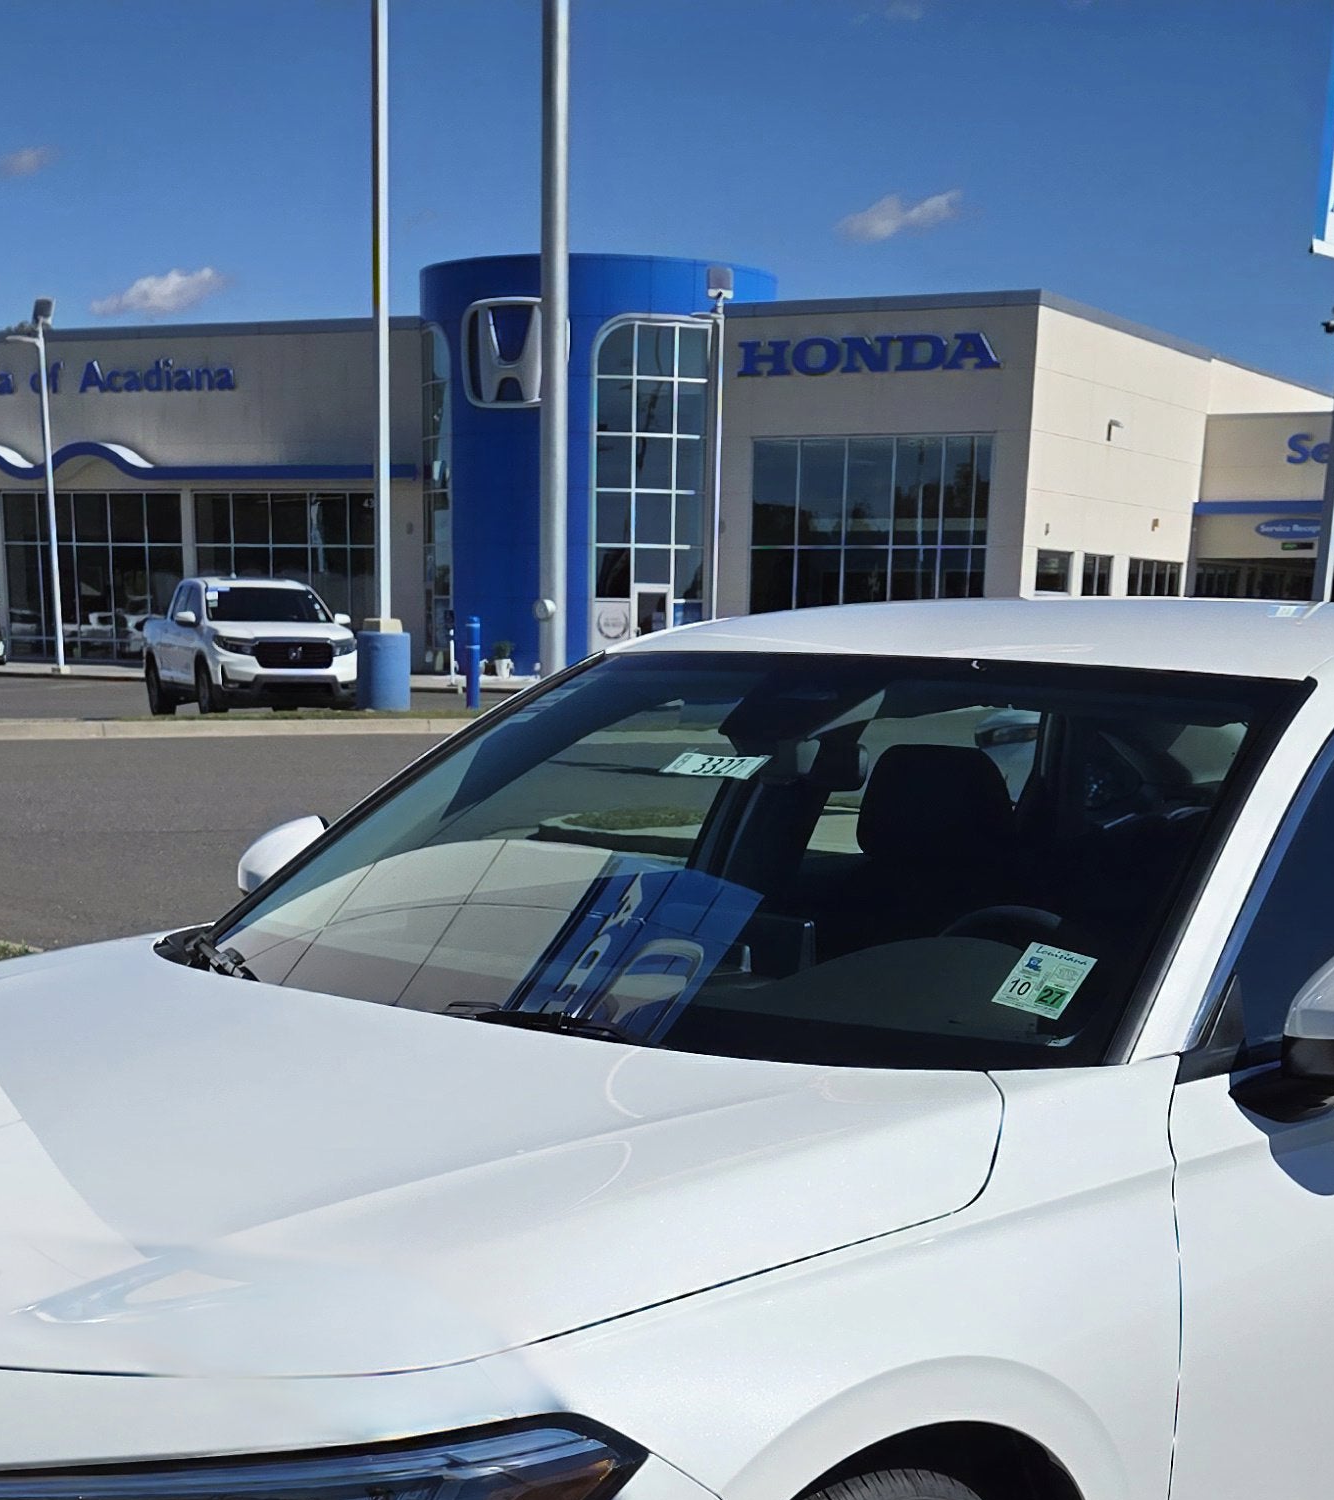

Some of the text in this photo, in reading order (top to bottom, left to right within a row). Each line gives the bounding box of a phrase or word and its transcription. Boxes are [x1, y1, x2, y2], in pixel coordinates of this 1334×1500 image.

[737, 332, 1002, 377] HONDA
[29, 360, 62, 394] of
[79, 358, 236, 394] Acadiana
[1035, 945, 1088, 966] Louisiana
[1008, 977, 1032, 996] 10
[1037, 988, 1066, 1006] 27
